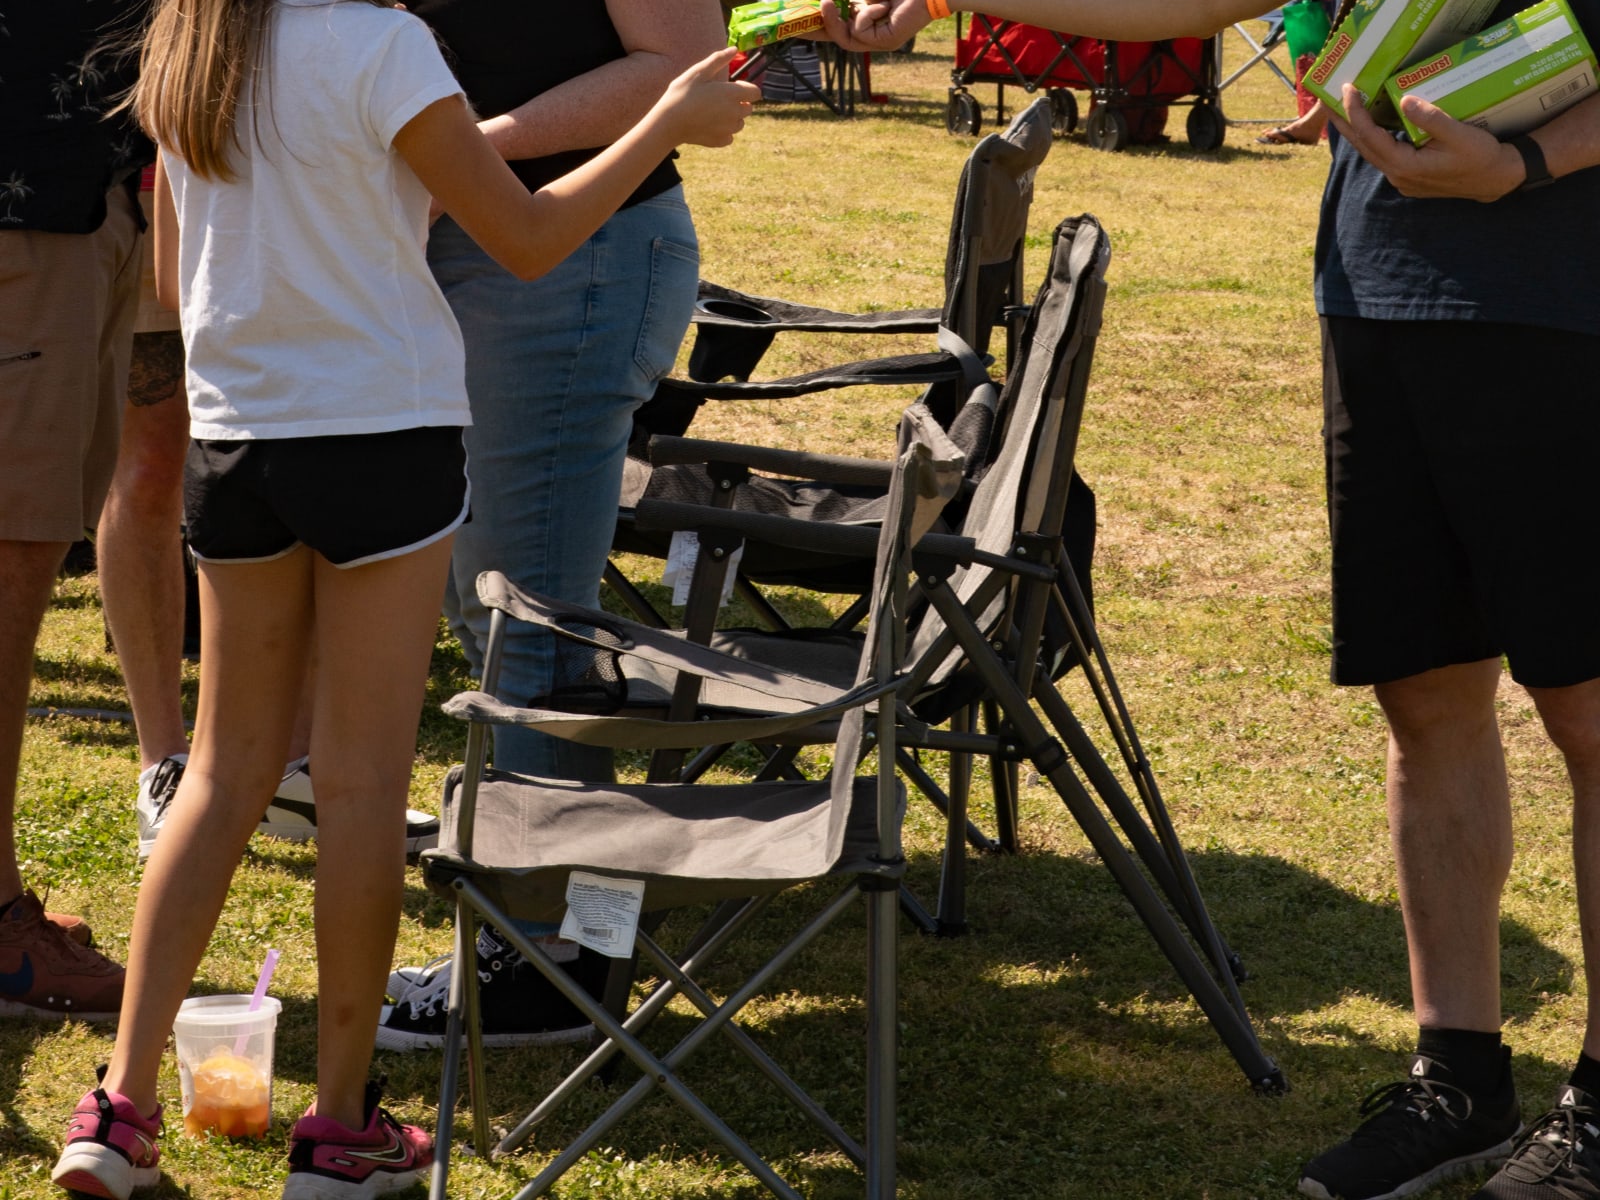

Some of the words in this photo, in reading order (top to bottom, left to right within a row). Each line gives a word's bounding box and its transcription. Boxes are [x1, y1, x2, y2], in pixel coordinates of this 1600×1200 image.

[777, 15, 824, 40] tarburst
[1311, 33, 1352, 84] Starburst
[1397, 55, 1451, 89] Starburst
